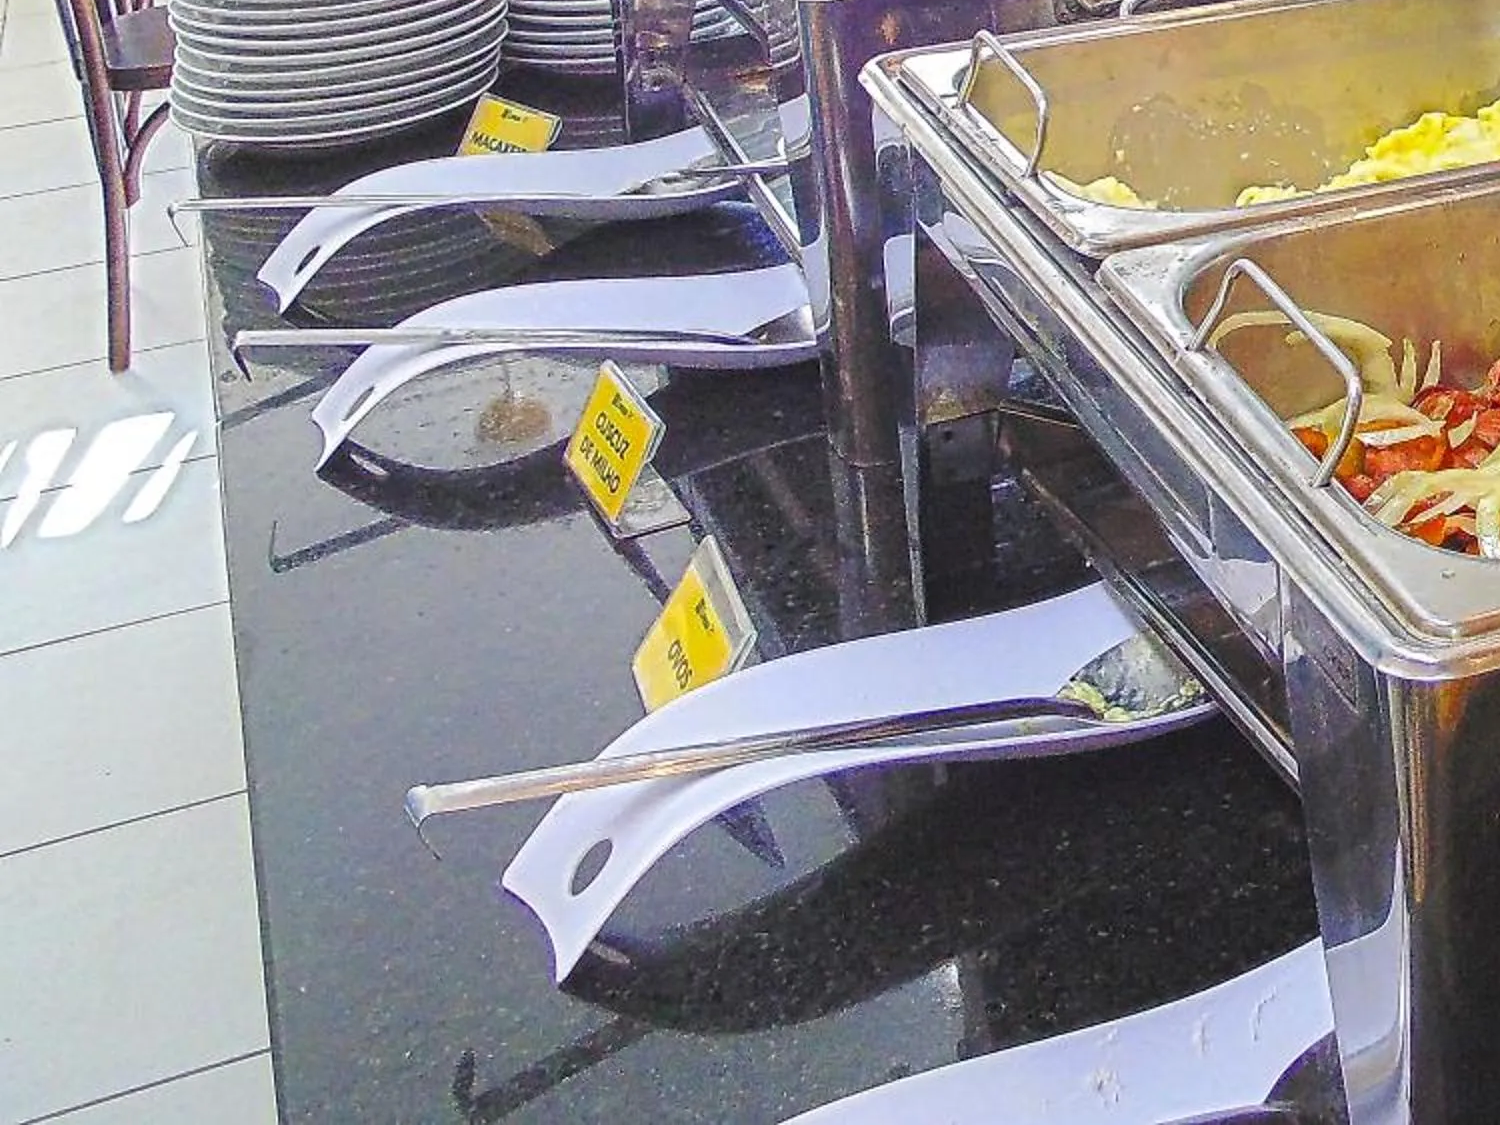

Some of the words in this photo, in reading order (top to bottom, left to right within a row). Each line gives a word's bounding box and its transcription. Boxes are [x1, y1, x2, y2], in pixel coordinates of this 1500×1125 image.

[595, 412, 630, 460] CUSCUZ
[579, 435, 595, 460] DE
[591, 448, 621, 494] MILHO
[667, 638, 693, 690] OVOS
